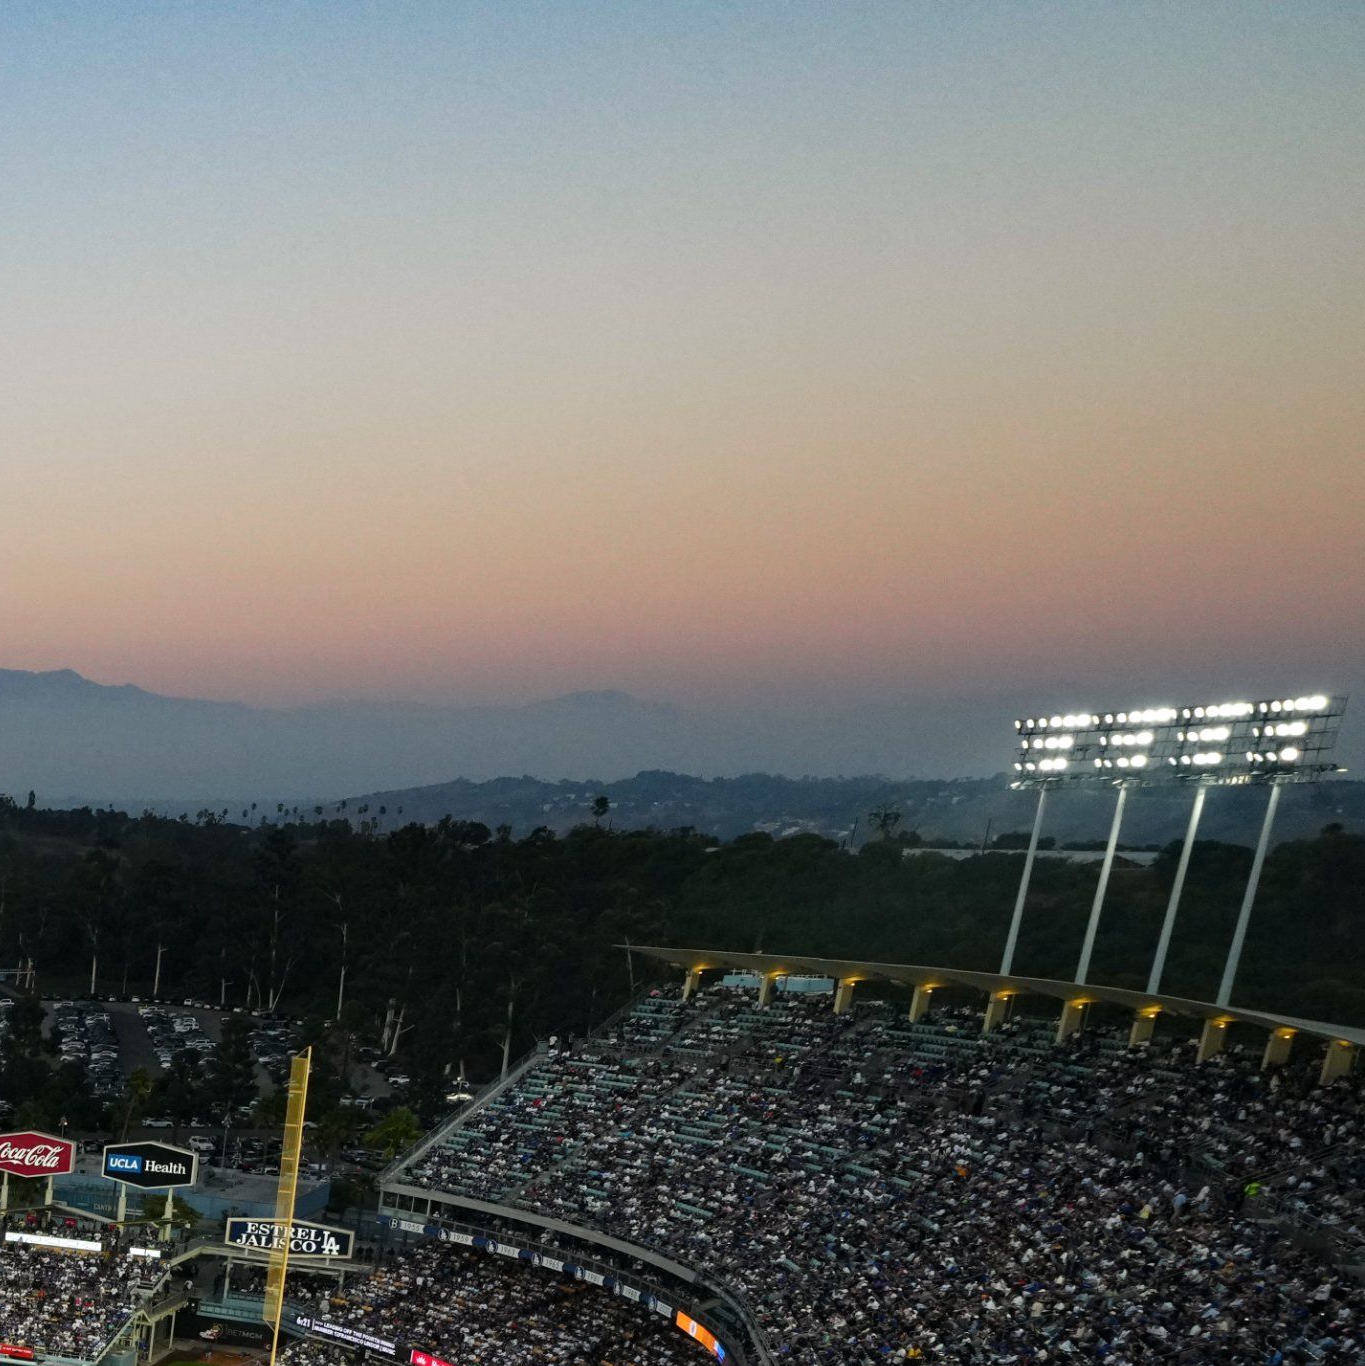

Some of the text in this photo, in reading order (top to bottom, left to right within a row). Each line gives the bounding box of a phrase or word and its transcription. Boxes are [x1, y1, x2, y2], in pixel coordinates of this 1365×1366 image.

[110, 1157, 186, 1175] UCLA Health
[404, 1222, 420, 1232] 1955
[236, 1233, 316, 1253] JALISCO
[453, 1233, 469, 1243] 1959
[296, 1316, 311, 1328] 6:21
[344, 1326, 353, 1335] OFF
[353, 1329, 362, 1338] THE
